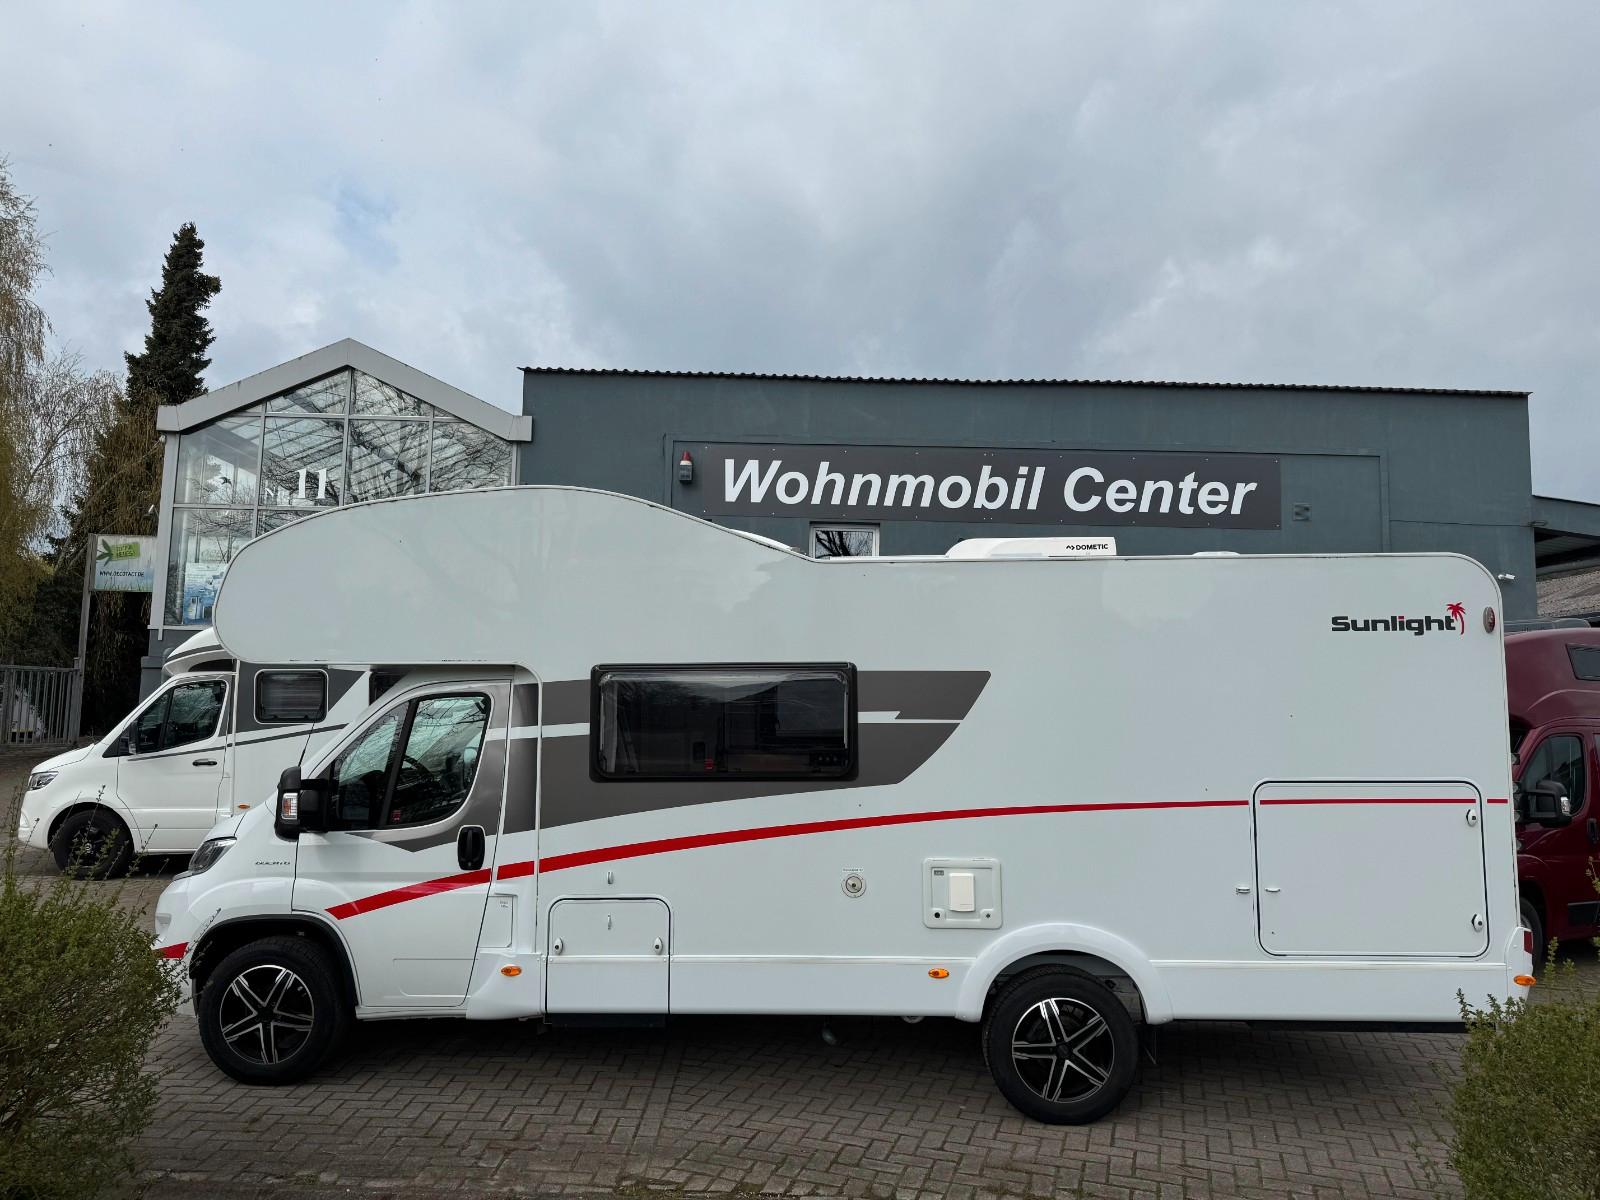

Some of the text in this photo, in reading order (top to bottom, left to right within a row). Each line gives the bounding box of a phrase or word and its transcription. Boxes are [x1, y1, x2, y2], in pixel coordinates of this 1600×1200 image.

[294, 468, 327, 499] 11
[724, 458, 1257, 515] Wohnmobil Center
[1331, 616, 1456, 636] Sunlight
